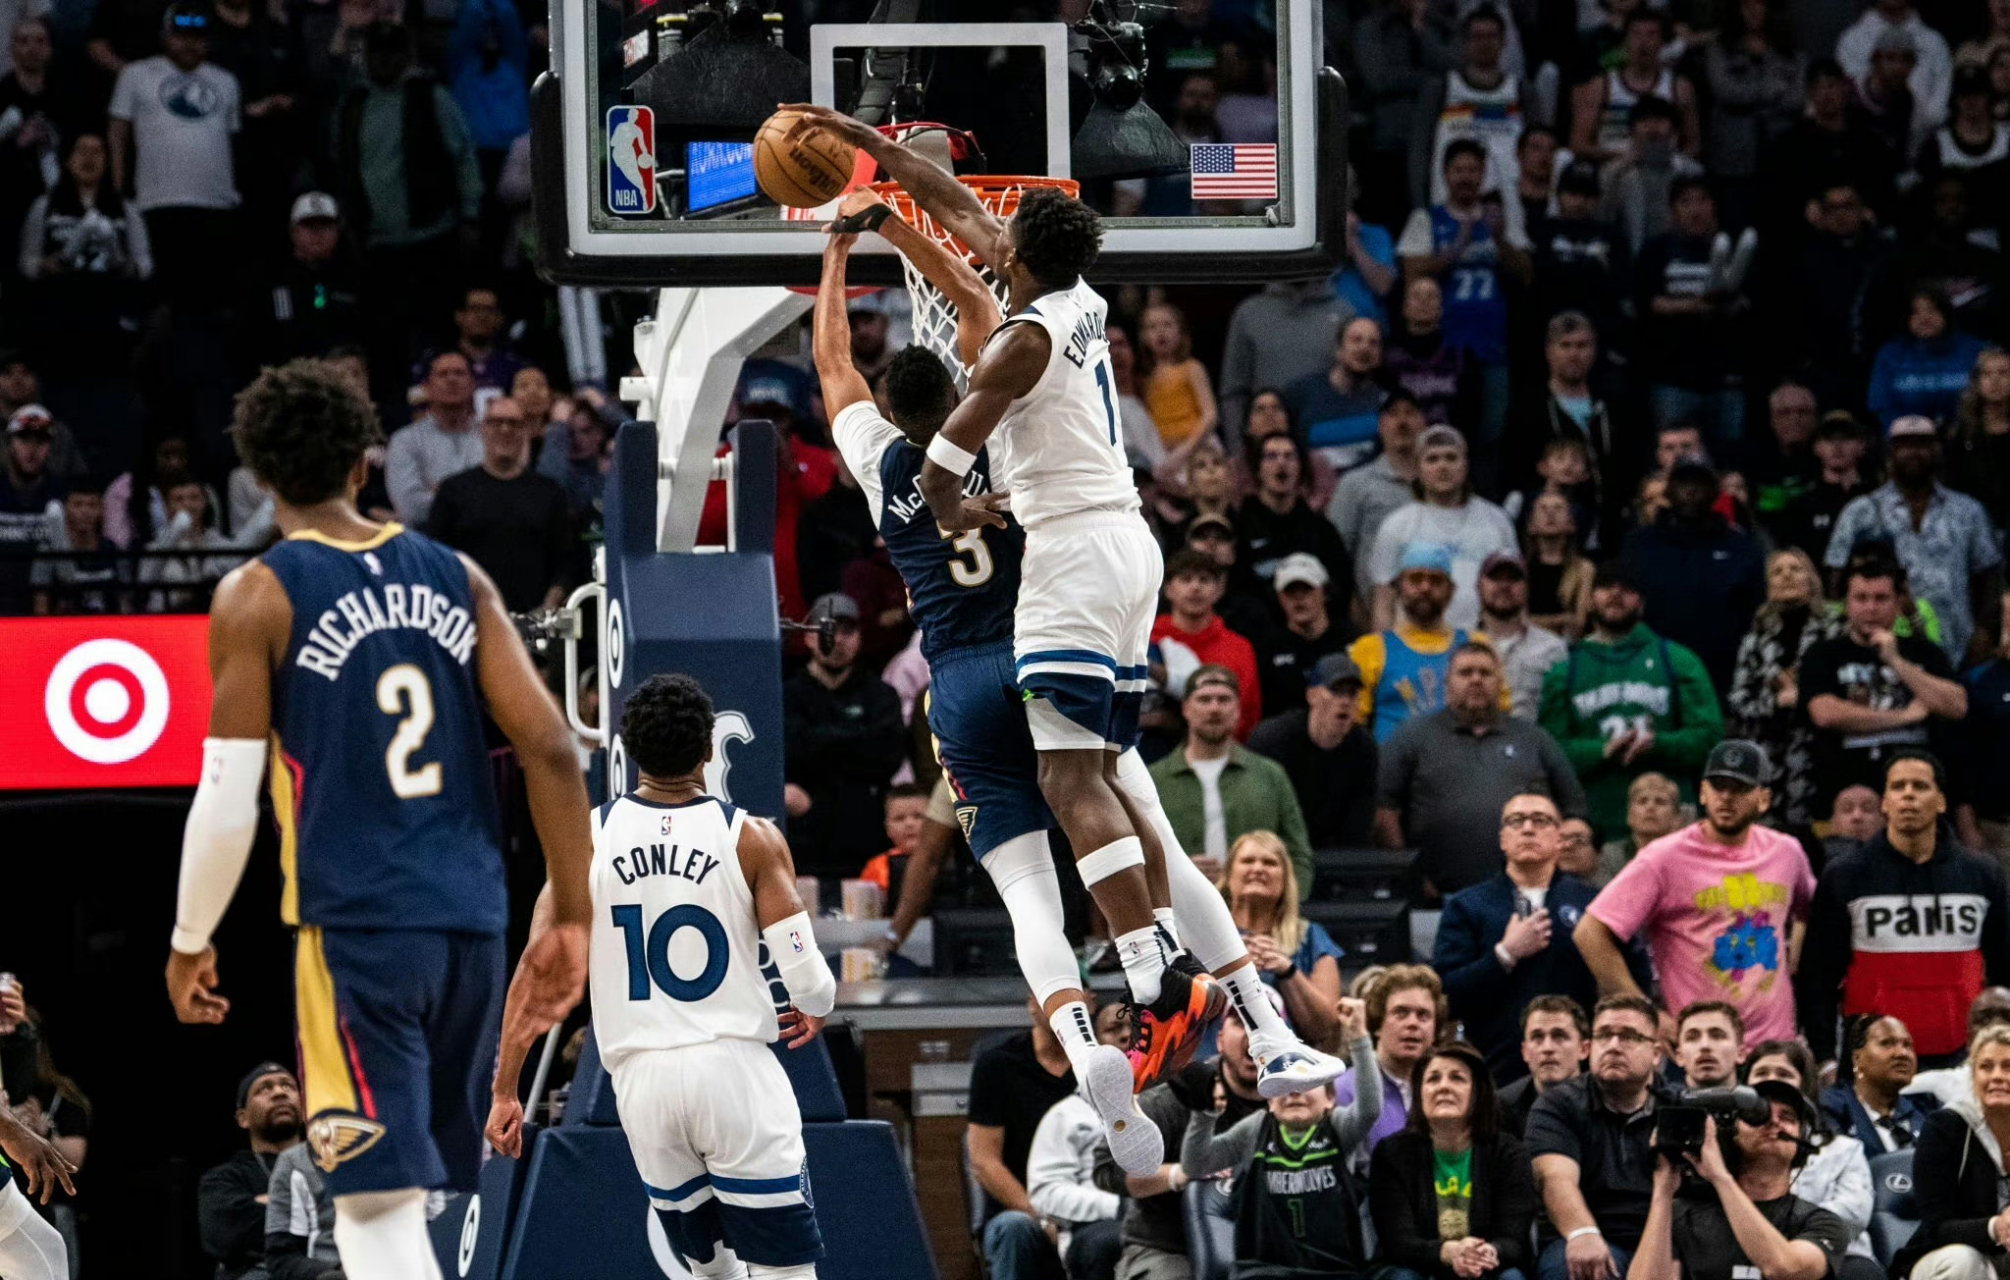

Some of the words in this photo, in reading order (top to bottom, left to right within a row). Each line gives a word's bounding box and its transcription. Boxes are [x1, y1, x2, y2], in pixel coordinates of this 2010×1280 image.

[615, 189, 638, 206] NBA
[1094, 359, 1117, 447] 1
[936, 519, 994, 588] 3
[296, 584, 478, 682] RICHARDSON
[376, 663, 443, 799] 2
[612, 843, 720, 886] CONLEY
[610, 903, 730, 1002] 10
[1287, 1199, 1306, 1238] 1
